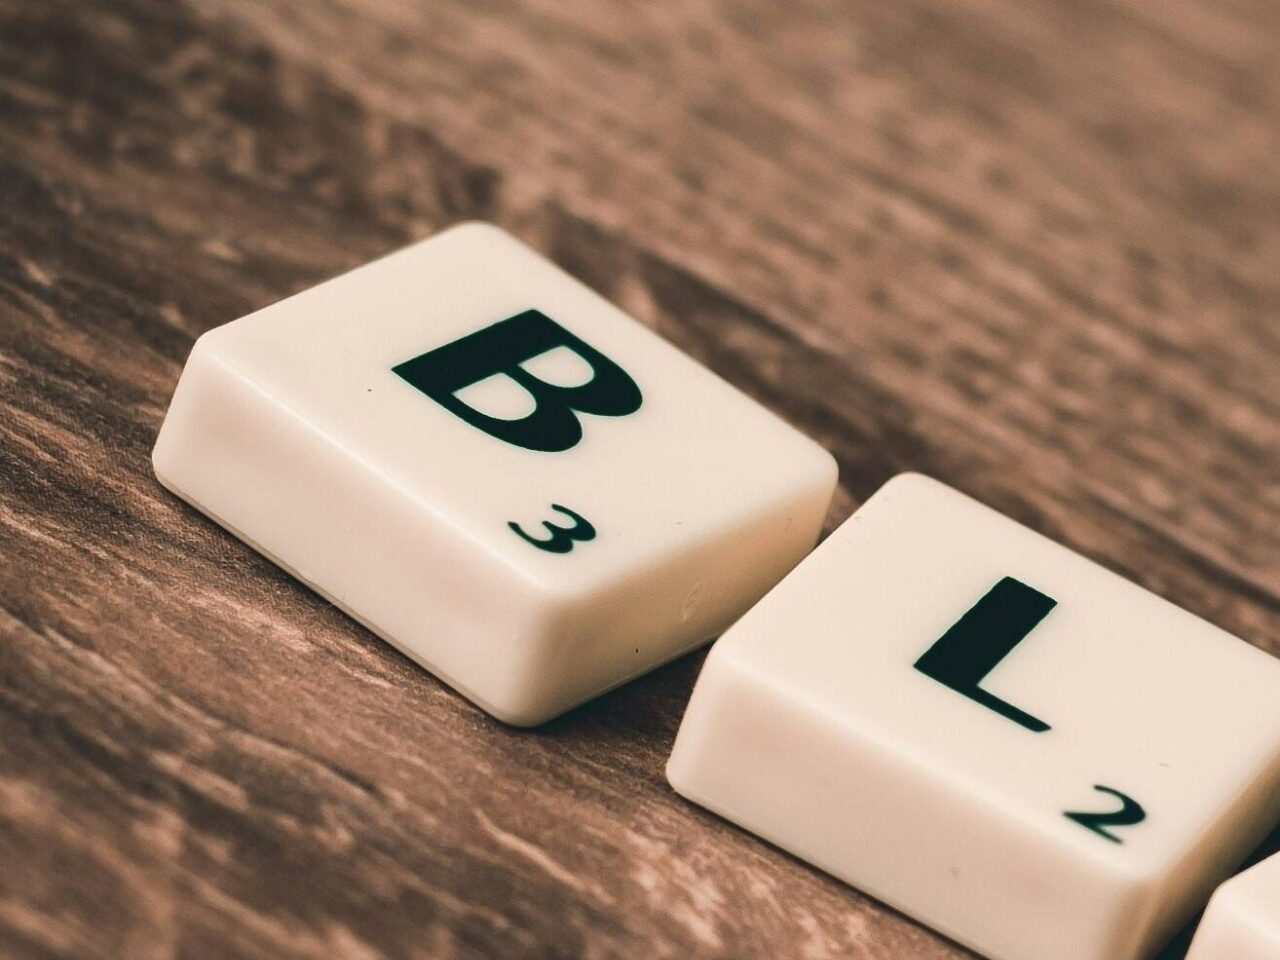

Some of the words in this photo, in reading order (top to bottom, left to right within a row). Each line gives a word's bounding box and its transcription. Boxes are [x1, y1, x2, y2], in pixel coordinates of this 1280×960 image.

[390, 308, 644, 453] B
[507, 503, 597, 555] 3
[912, 575, 1058, 733] L
[1063, 784, 1147, 844] 2
